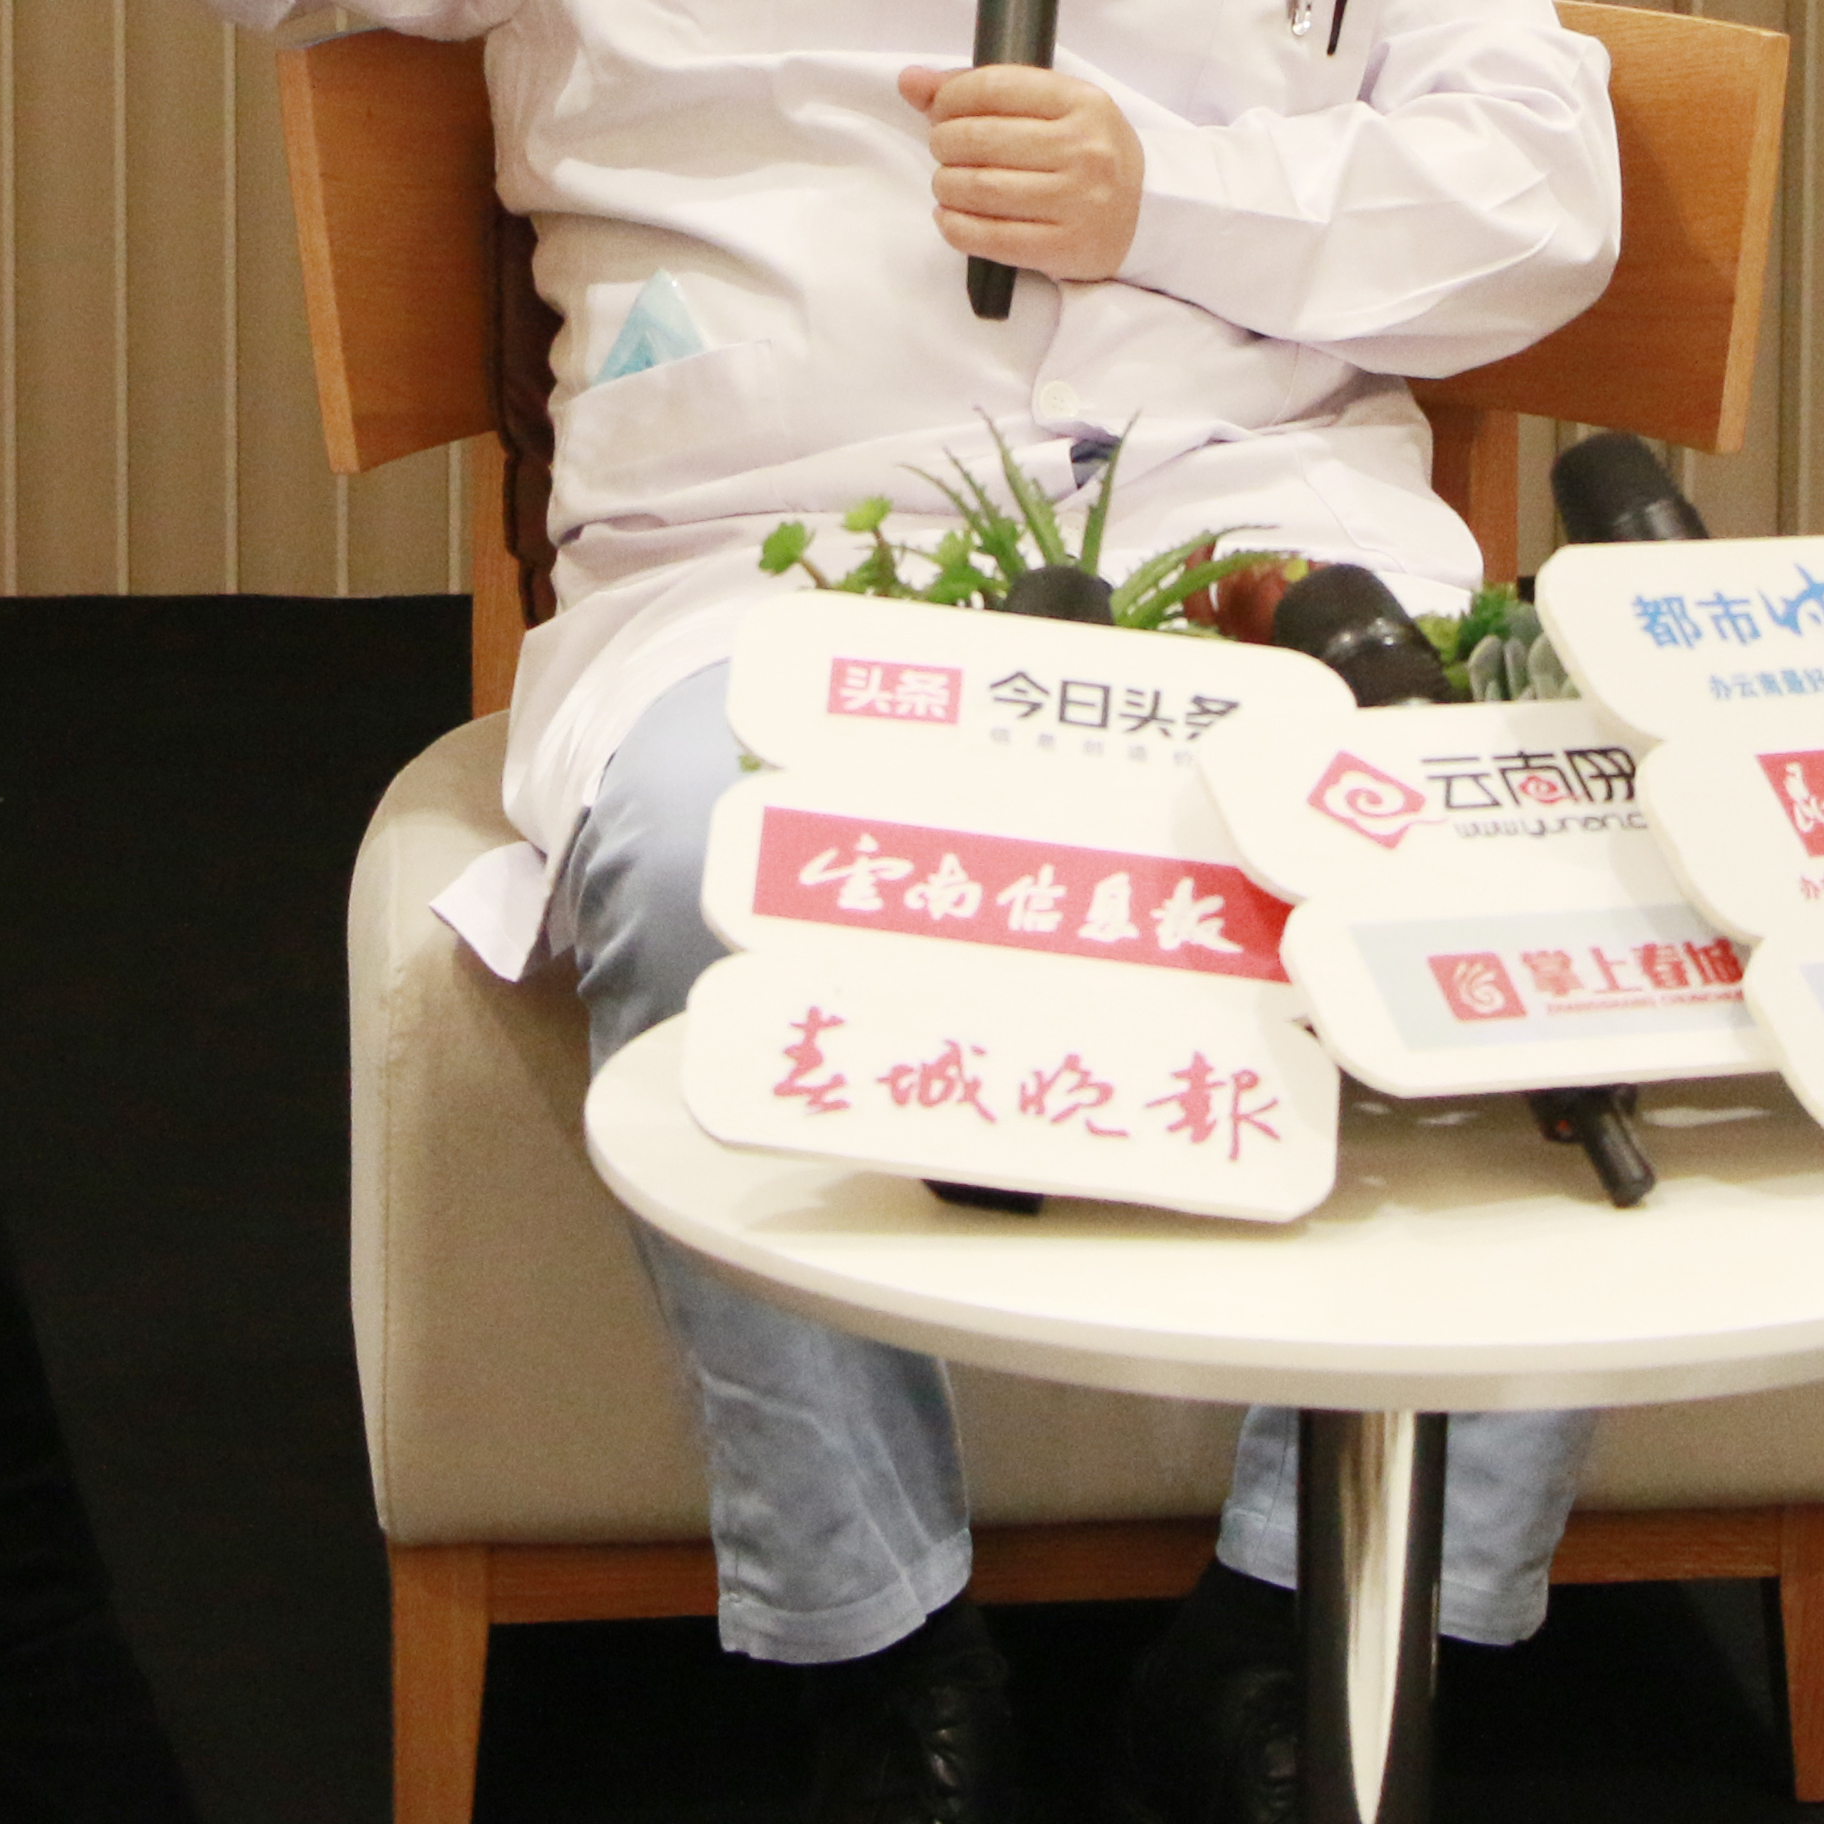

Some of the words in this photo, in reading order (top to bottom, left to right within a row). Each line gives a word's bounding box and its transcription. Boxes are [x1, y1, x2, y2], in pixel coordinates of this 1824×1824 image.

[840, 665, 951, 717] 头条
[1422, 747, 1635, 810] 云南网
